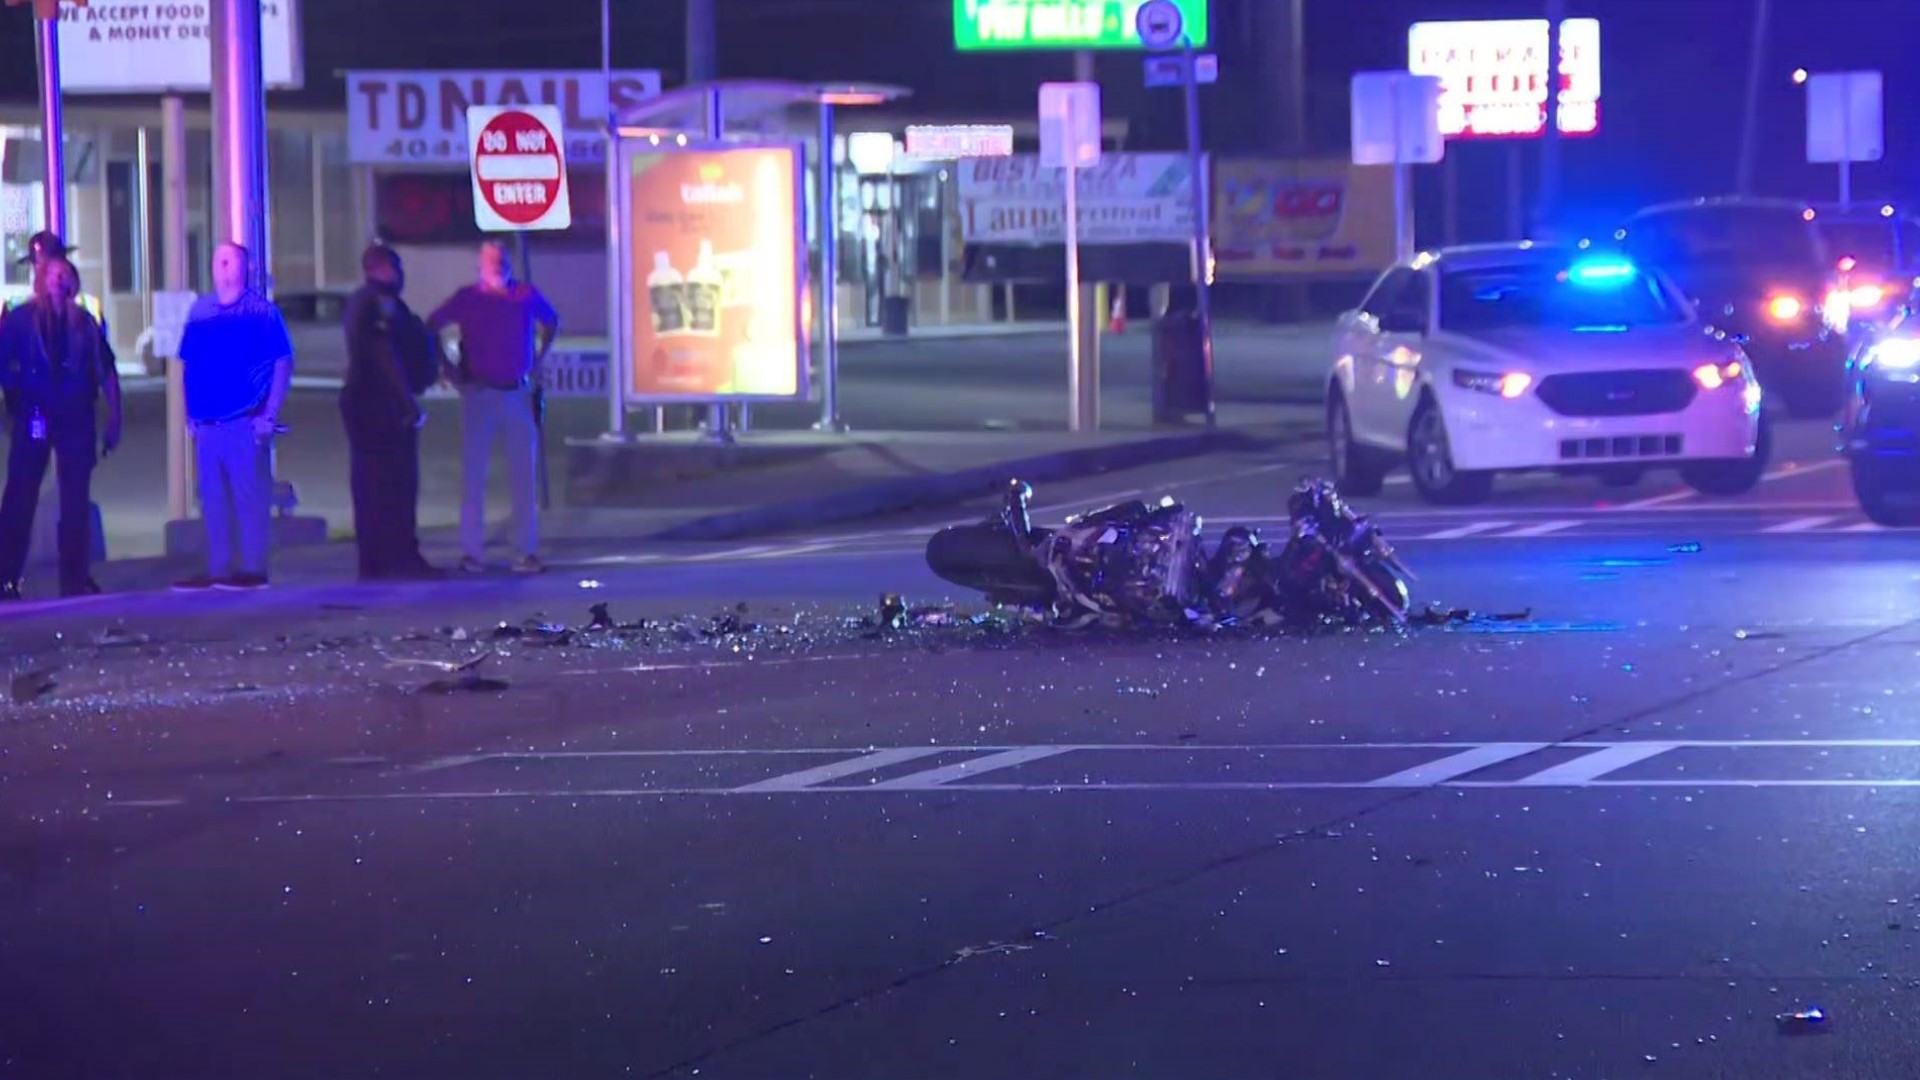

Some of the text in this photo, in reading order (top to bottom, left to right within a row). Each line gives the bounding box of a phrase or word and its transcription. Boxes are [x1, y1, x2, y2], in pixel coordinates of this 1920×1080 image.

[86, 5, 149, 21] ACCEPT
[155, 4, 205, 20] FOOD
[108, 25, 170, 41] MONEY
[482, 129, 508, 153] DO
[515, 128, 548, 152] NOT
[492, 182, 547, 205] ENTER
